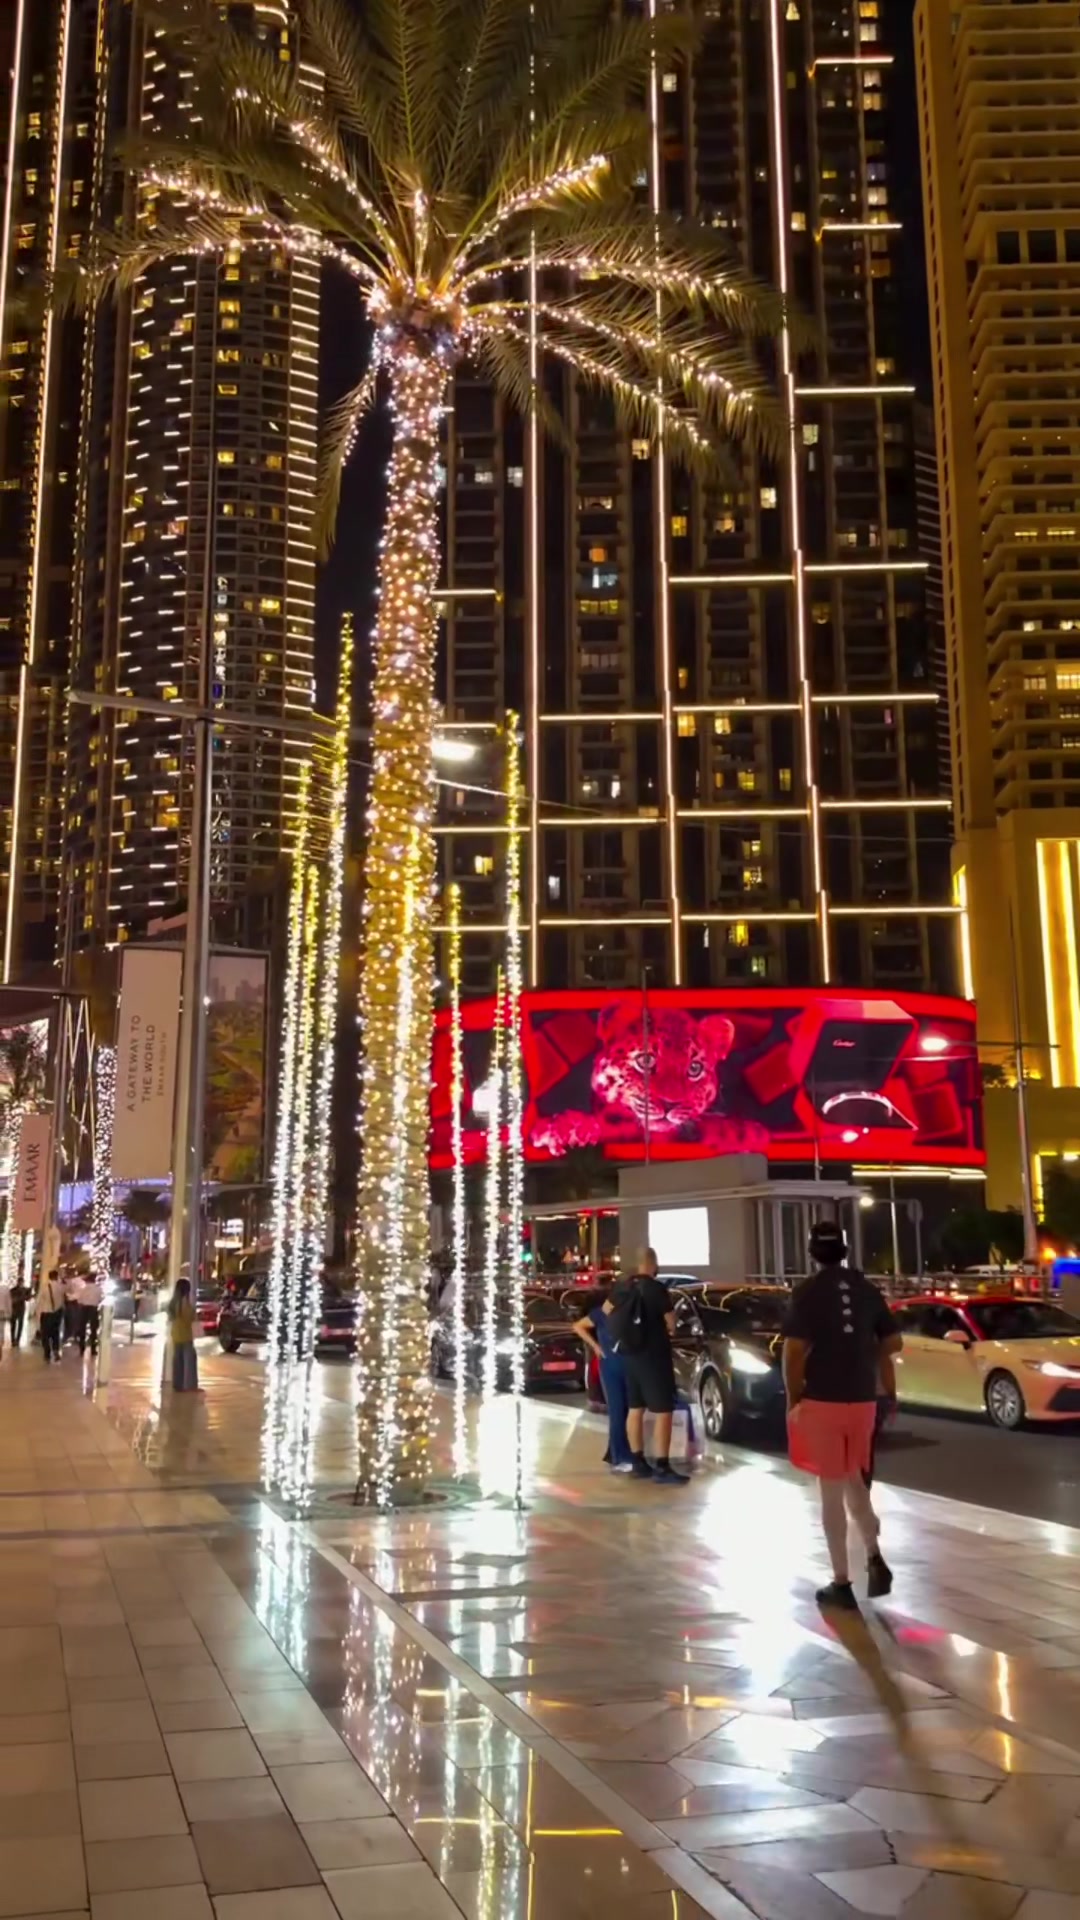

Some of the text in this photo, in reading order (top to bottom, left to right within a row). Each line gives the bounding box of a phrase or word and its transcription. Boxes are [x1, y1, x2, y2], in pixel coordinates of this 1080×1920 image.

[127, 1015, 141, 1113] A GATEWAY TO
[142, 1024, 156, 1104] THE WORLD
[23, 1143, 41, 1202] EMAAR
